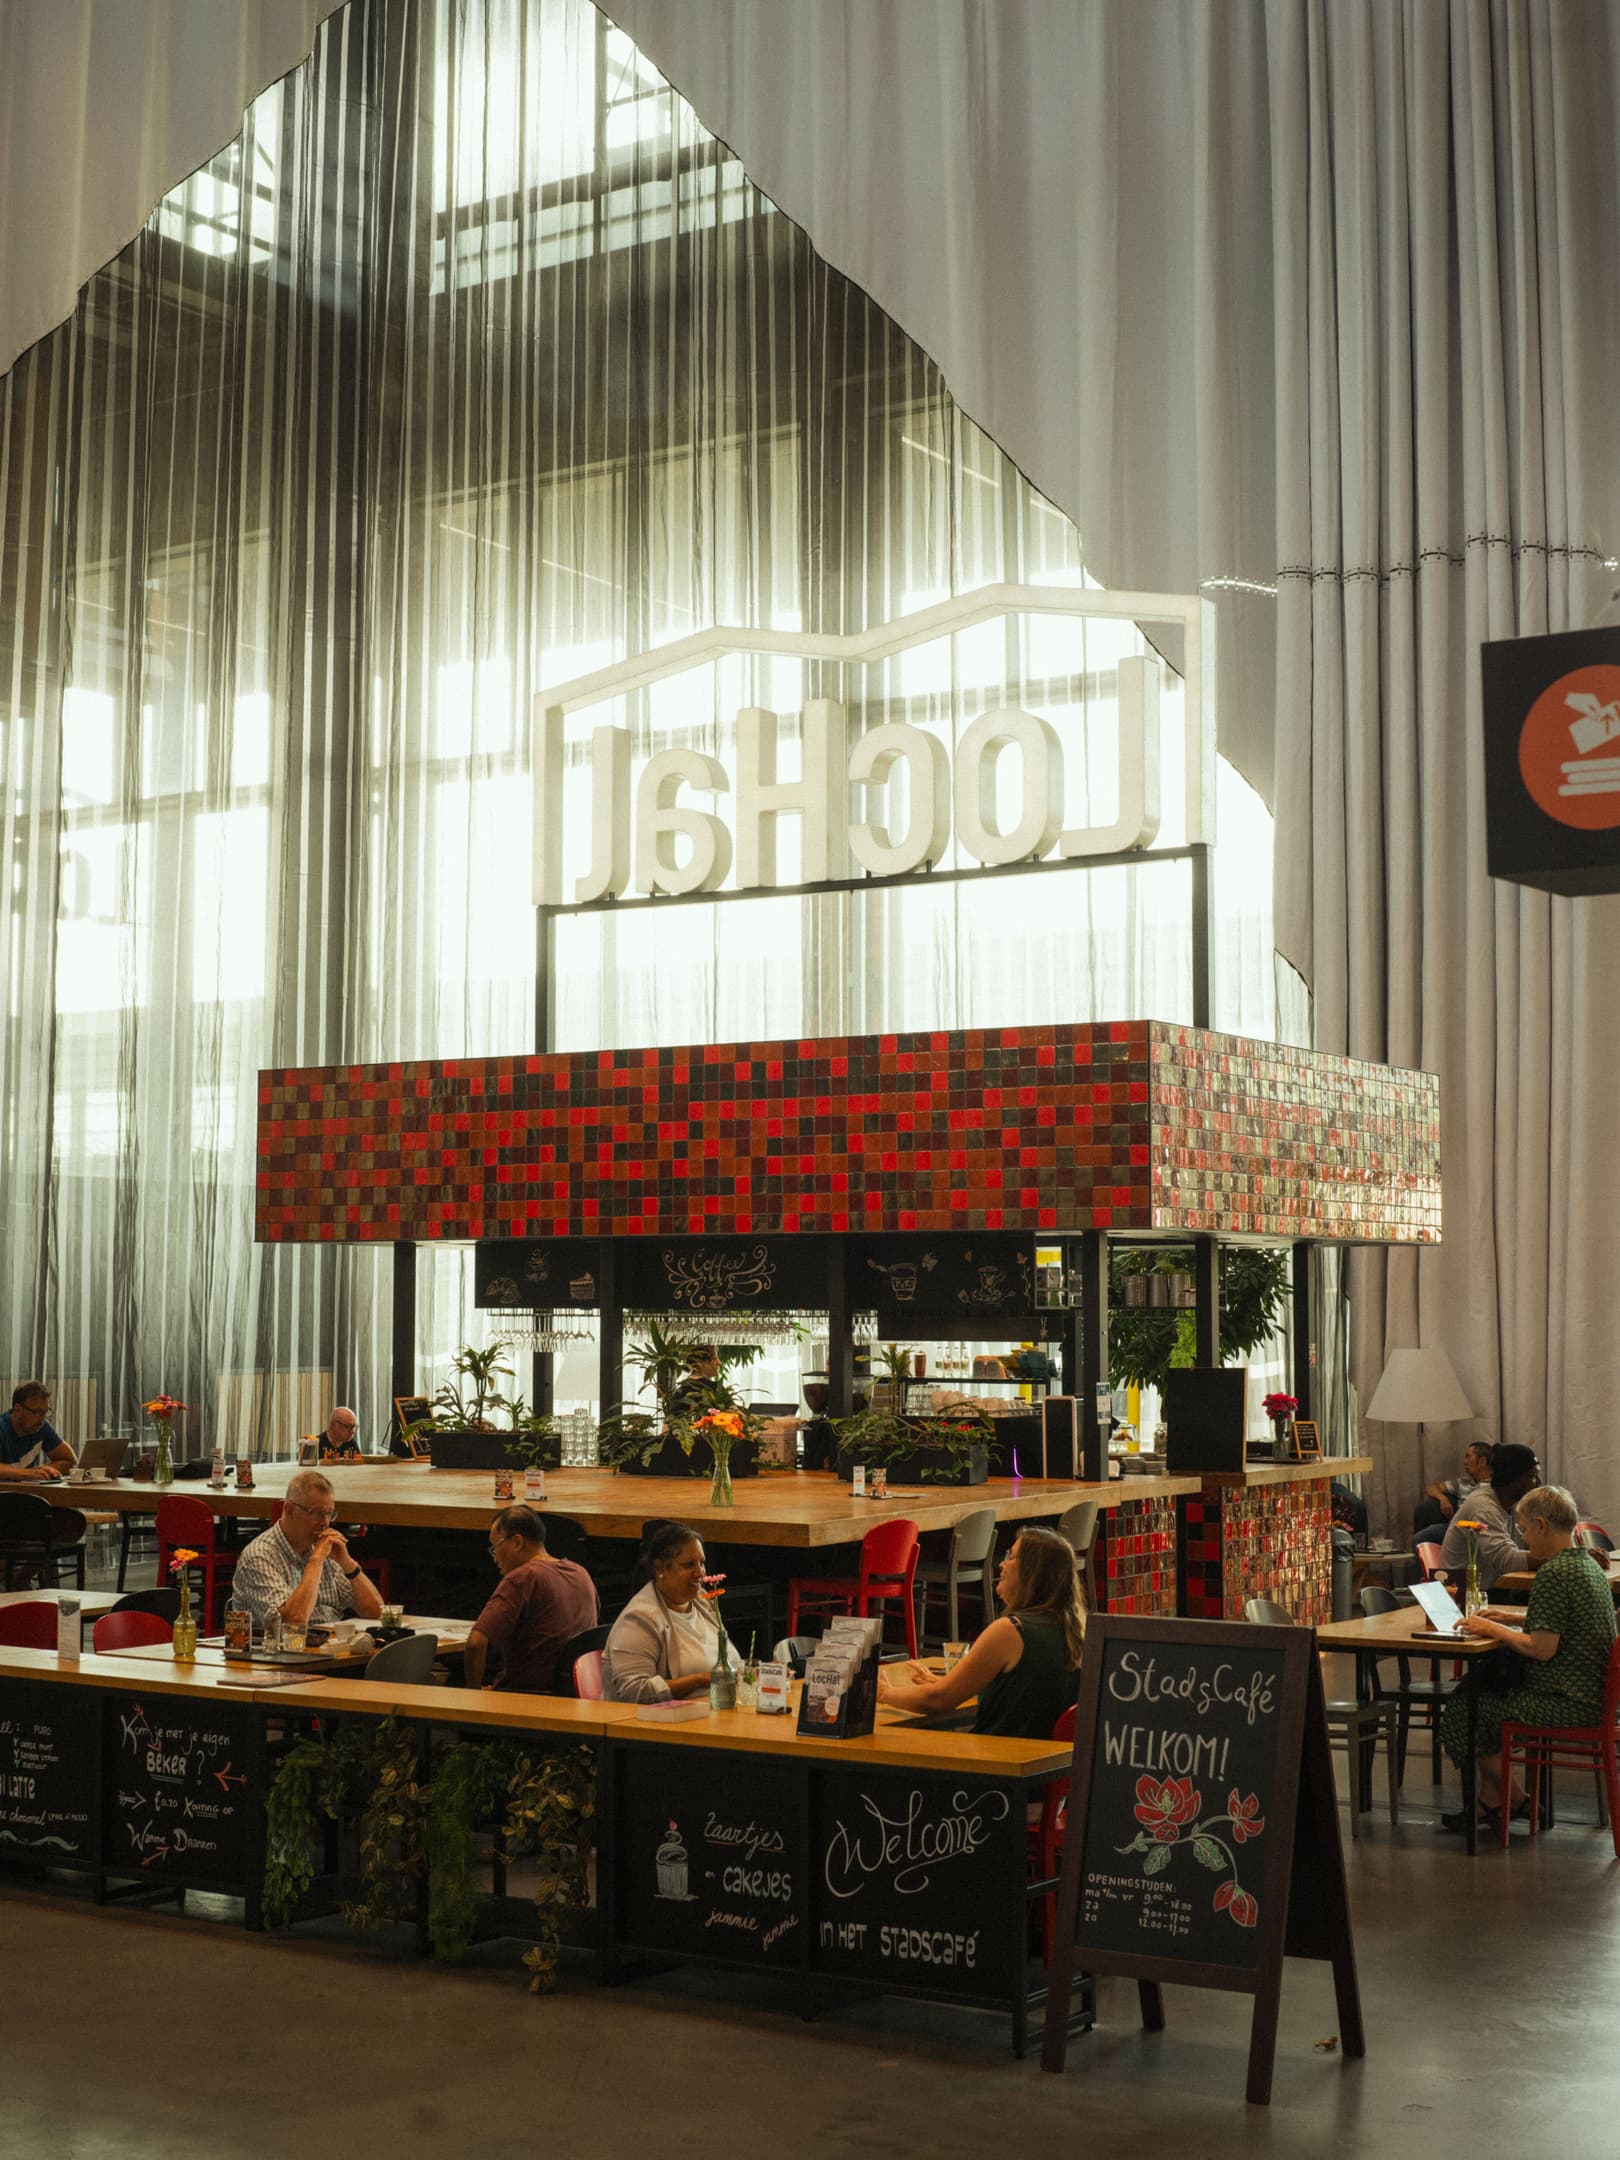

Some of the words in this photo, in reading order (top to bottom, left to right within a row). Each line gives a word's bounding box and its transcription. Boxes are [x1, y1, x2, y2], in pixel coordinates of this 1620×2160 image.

[692, 1248, 747, 1282] Coffee
[1108, 1650, 1276, 1726] StadsCafé
[202, 1729, 230, 1757] eigen
[1104, 1720, 1230, 1782] WELKOM!
[826, 1791, 1000, 1887] Welcome
[1084, 1900, 1100, 1910] za
[1085, 1888, 1101, 1898] ma
[1122, 1893, 1135, 1901] vr
[704, 1906, 760, 1931] jammie
[1084, 1912, 1098, 1922] zo
